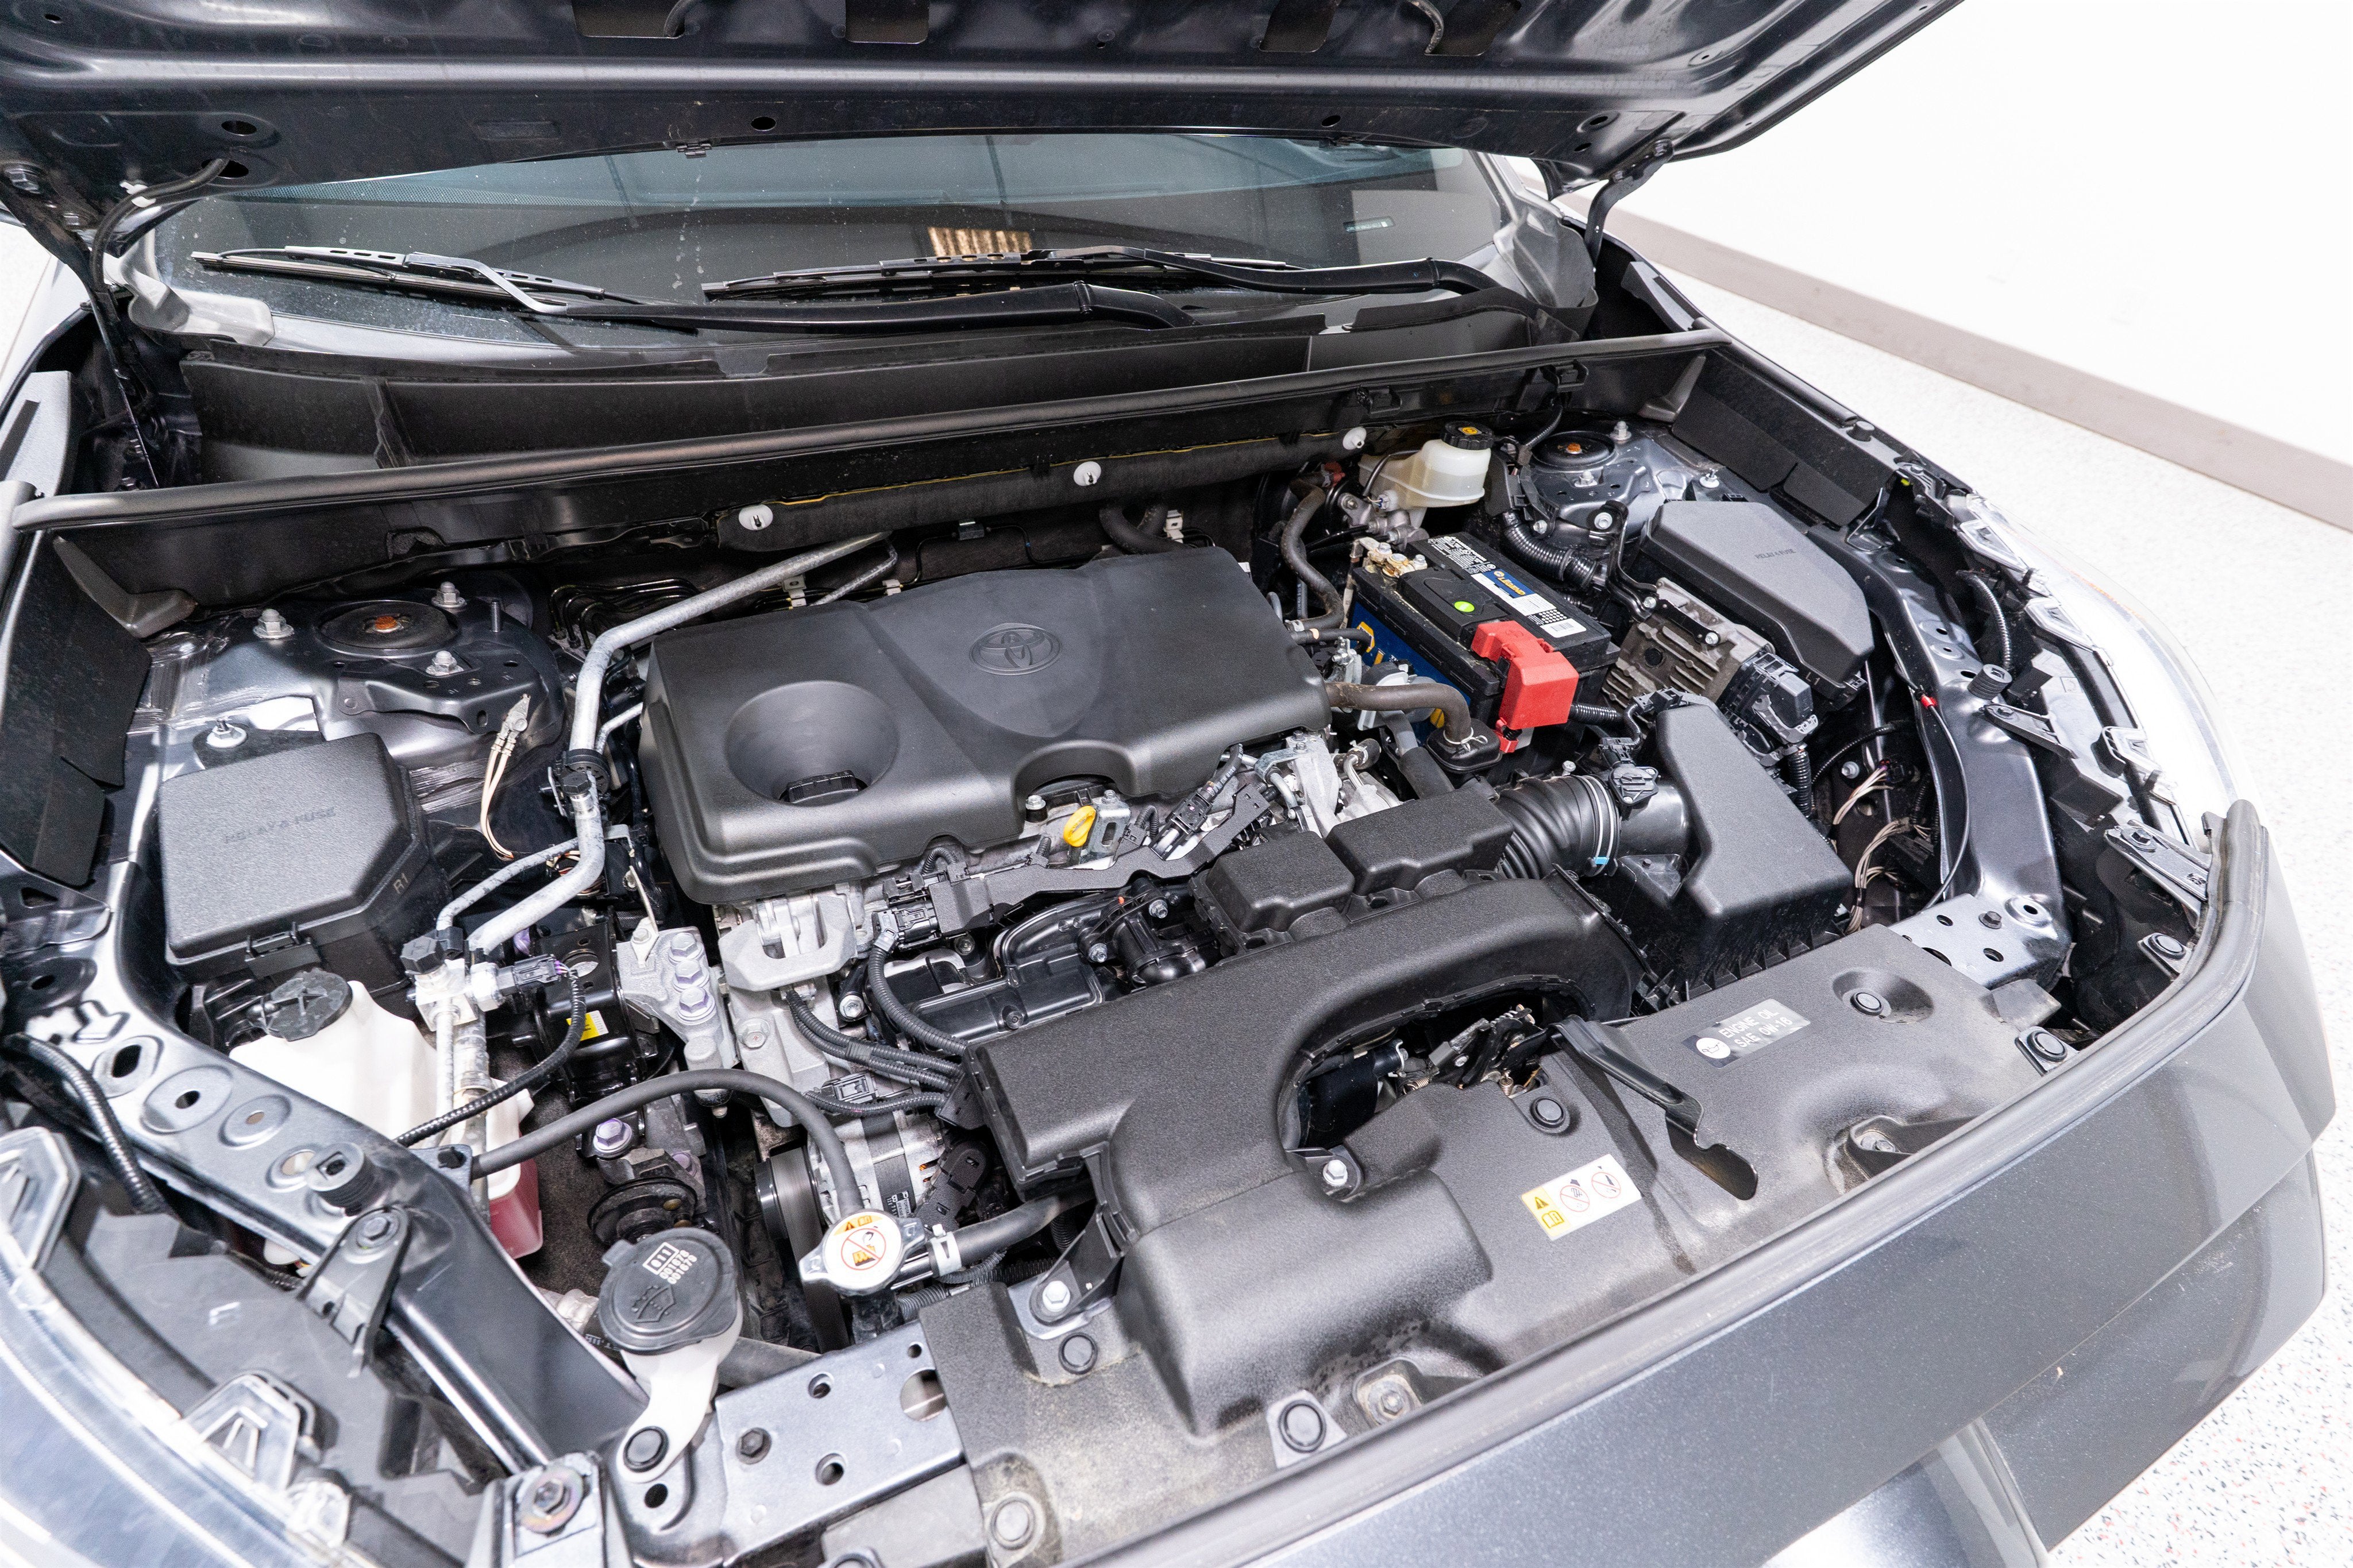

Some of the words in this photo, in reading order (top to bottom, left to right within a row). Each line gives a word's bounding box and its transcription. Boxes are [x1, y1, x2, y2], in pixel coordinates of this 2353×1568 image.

[1497, 577, 1526, 596] LEGEND
[1805, 671, 1820, 686] L1
[294, 806, 337, 825] FUSE
[393, 872, 409, 895] R1
[1718, 1016, 1760, 1038] ENGINE
[1757, 1009, 1780, 1020] OIL
[1734, 1032, 1761, 1048] SAE
[667, 1254, 698, 1285] 001679
